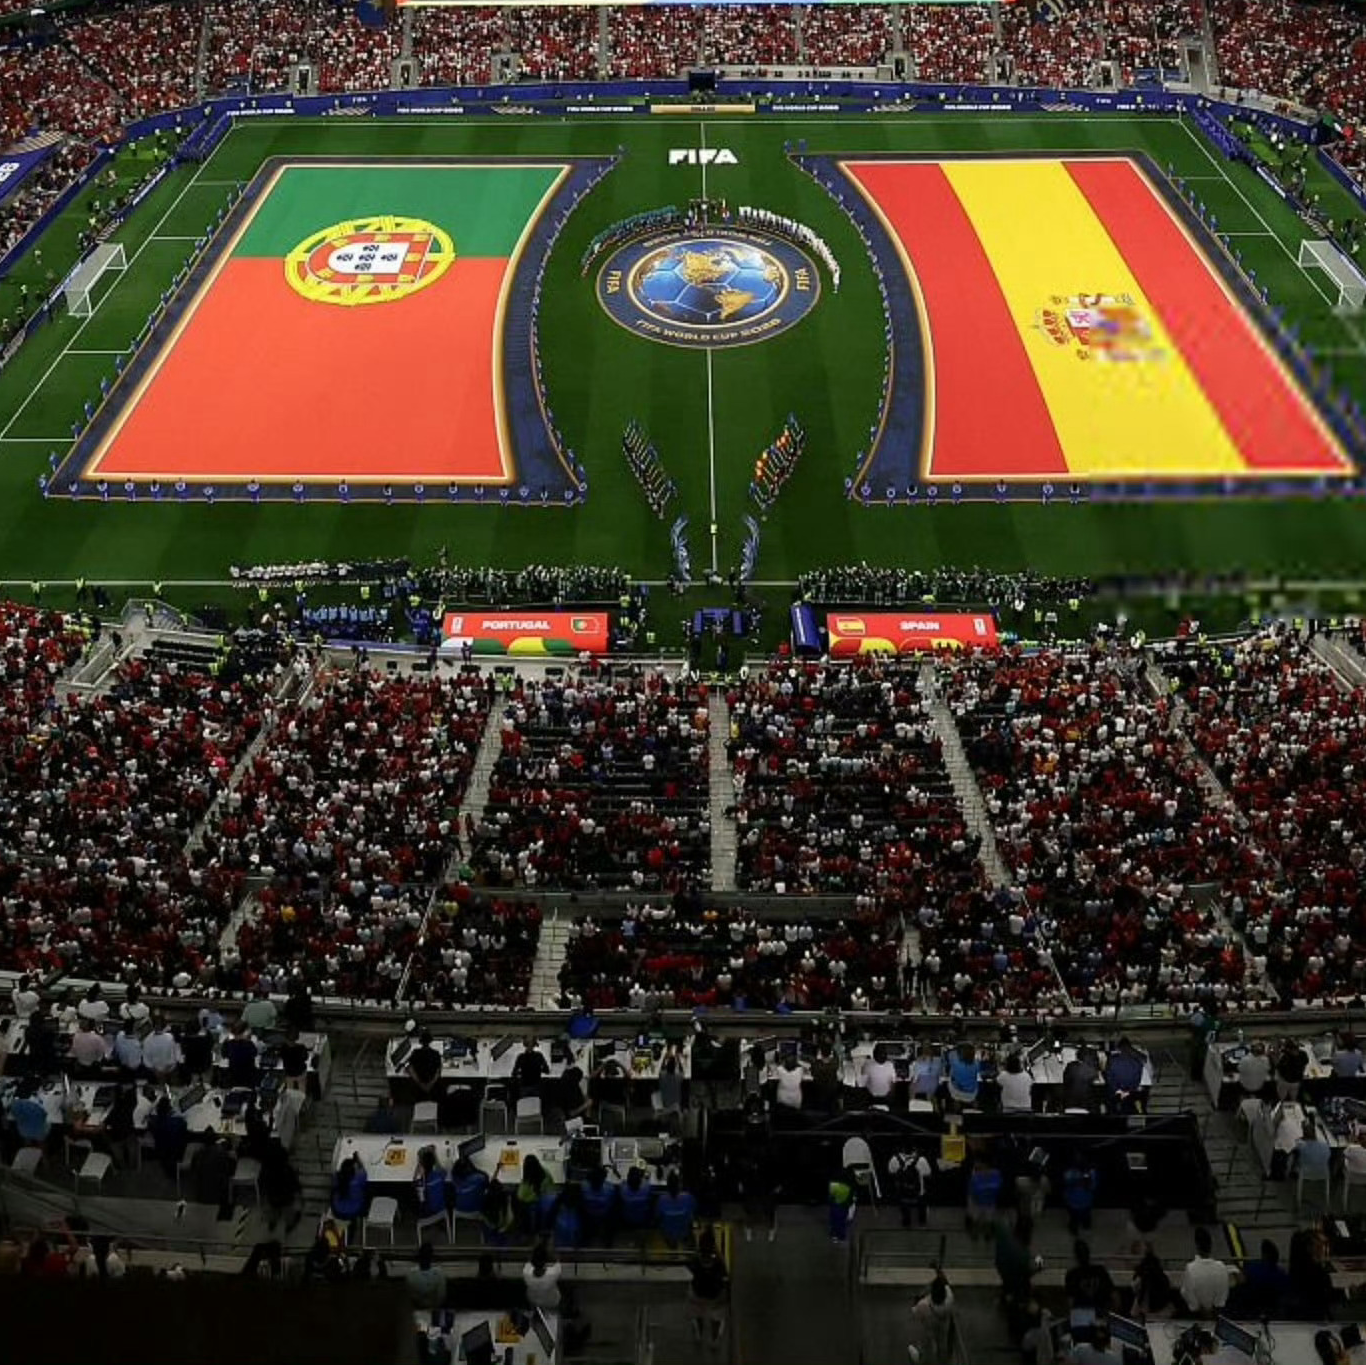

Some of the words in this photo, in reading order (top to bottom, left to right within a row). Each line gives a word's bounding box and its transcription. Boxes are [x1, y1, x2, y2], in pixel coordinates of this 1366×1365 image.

[668, 147, 740, 165] FIFA
[481, 620, 552, 630] PORTUGAL
[899, 620, 941, 631] SPAIN
